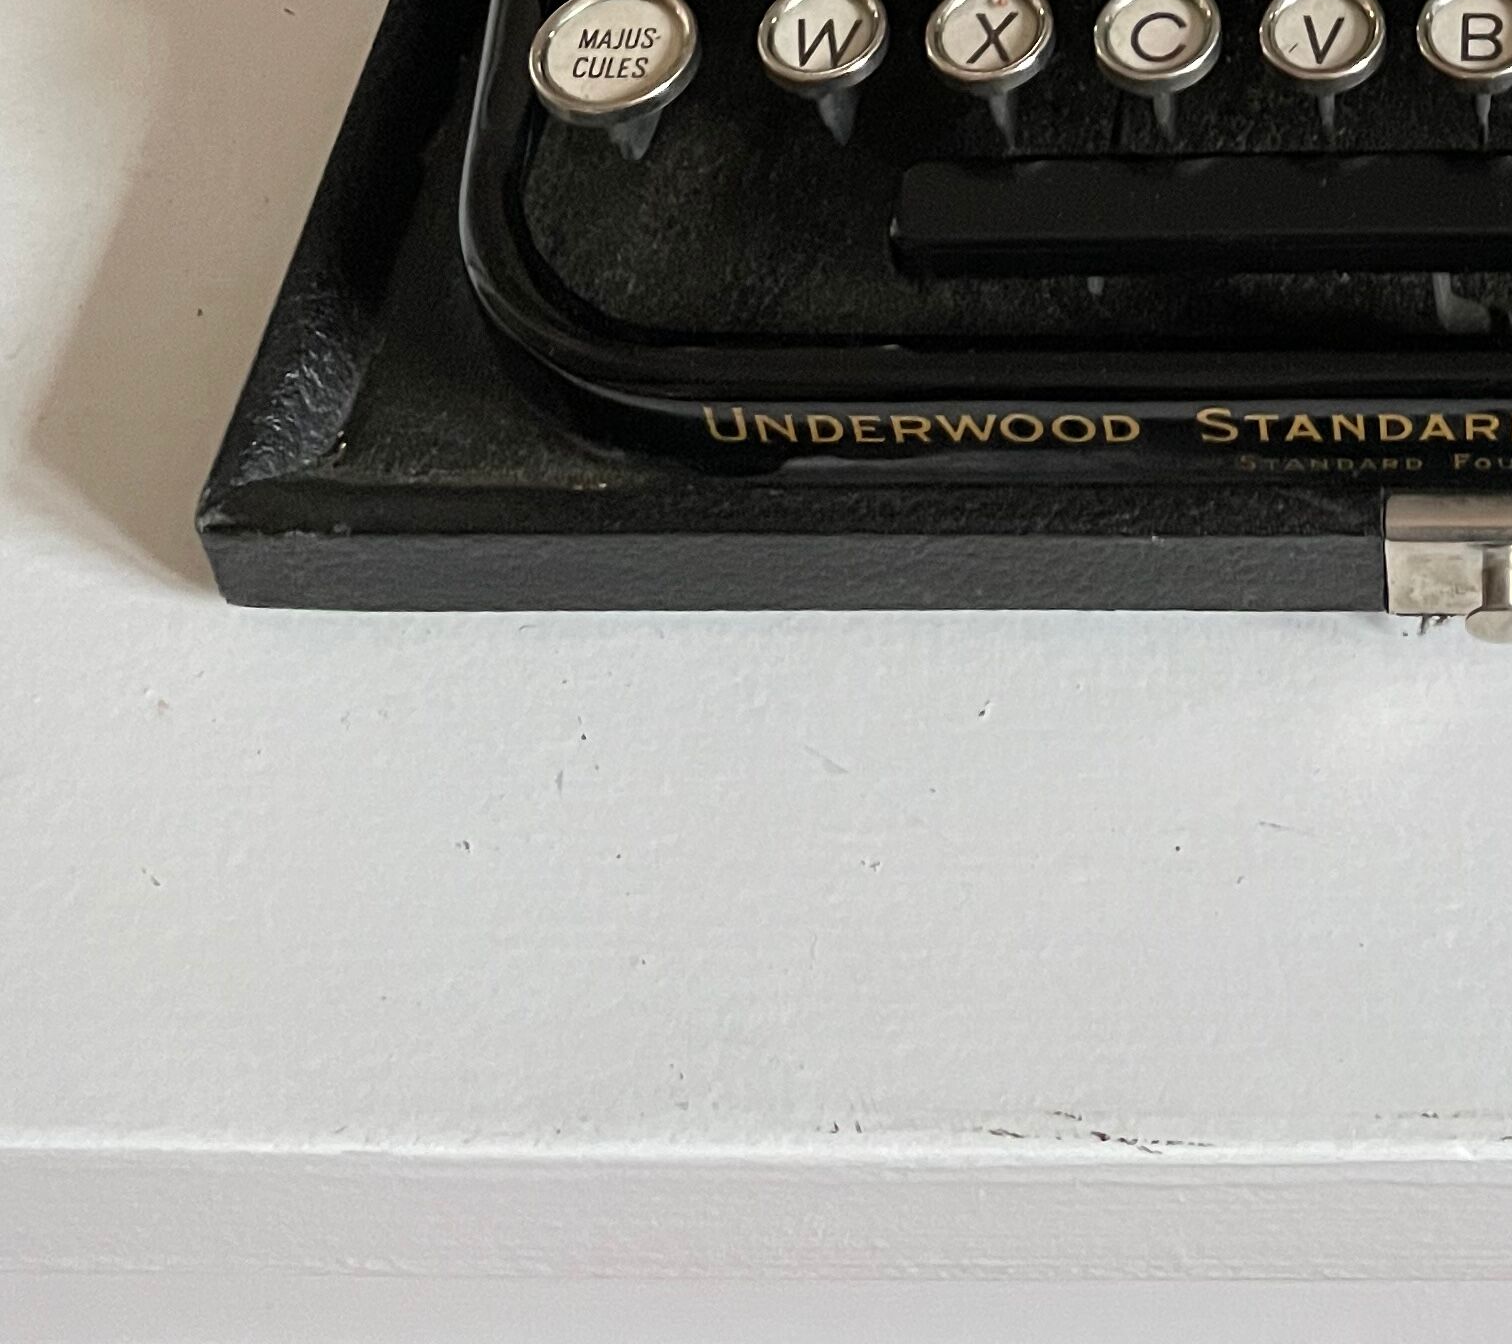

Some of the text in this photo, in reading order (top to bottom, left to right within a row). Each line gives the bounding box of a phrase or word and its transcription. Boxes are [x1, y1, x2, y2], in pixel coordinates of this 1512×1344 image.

[578, 27, 661, 50] MAJUS-
[799, 18, 861, 68] W
[966, 12, 1018, 64] X
[1130, 13, 1187, 63] C
[1303, 16, 1344, 64] V
[1461, 14, 1503, 62] B
[572, 56, 649, 78] CULES
[702, 406, 1141, 444] UNDERWOOD
[1239, 454, 1423, 471] STANDARD
